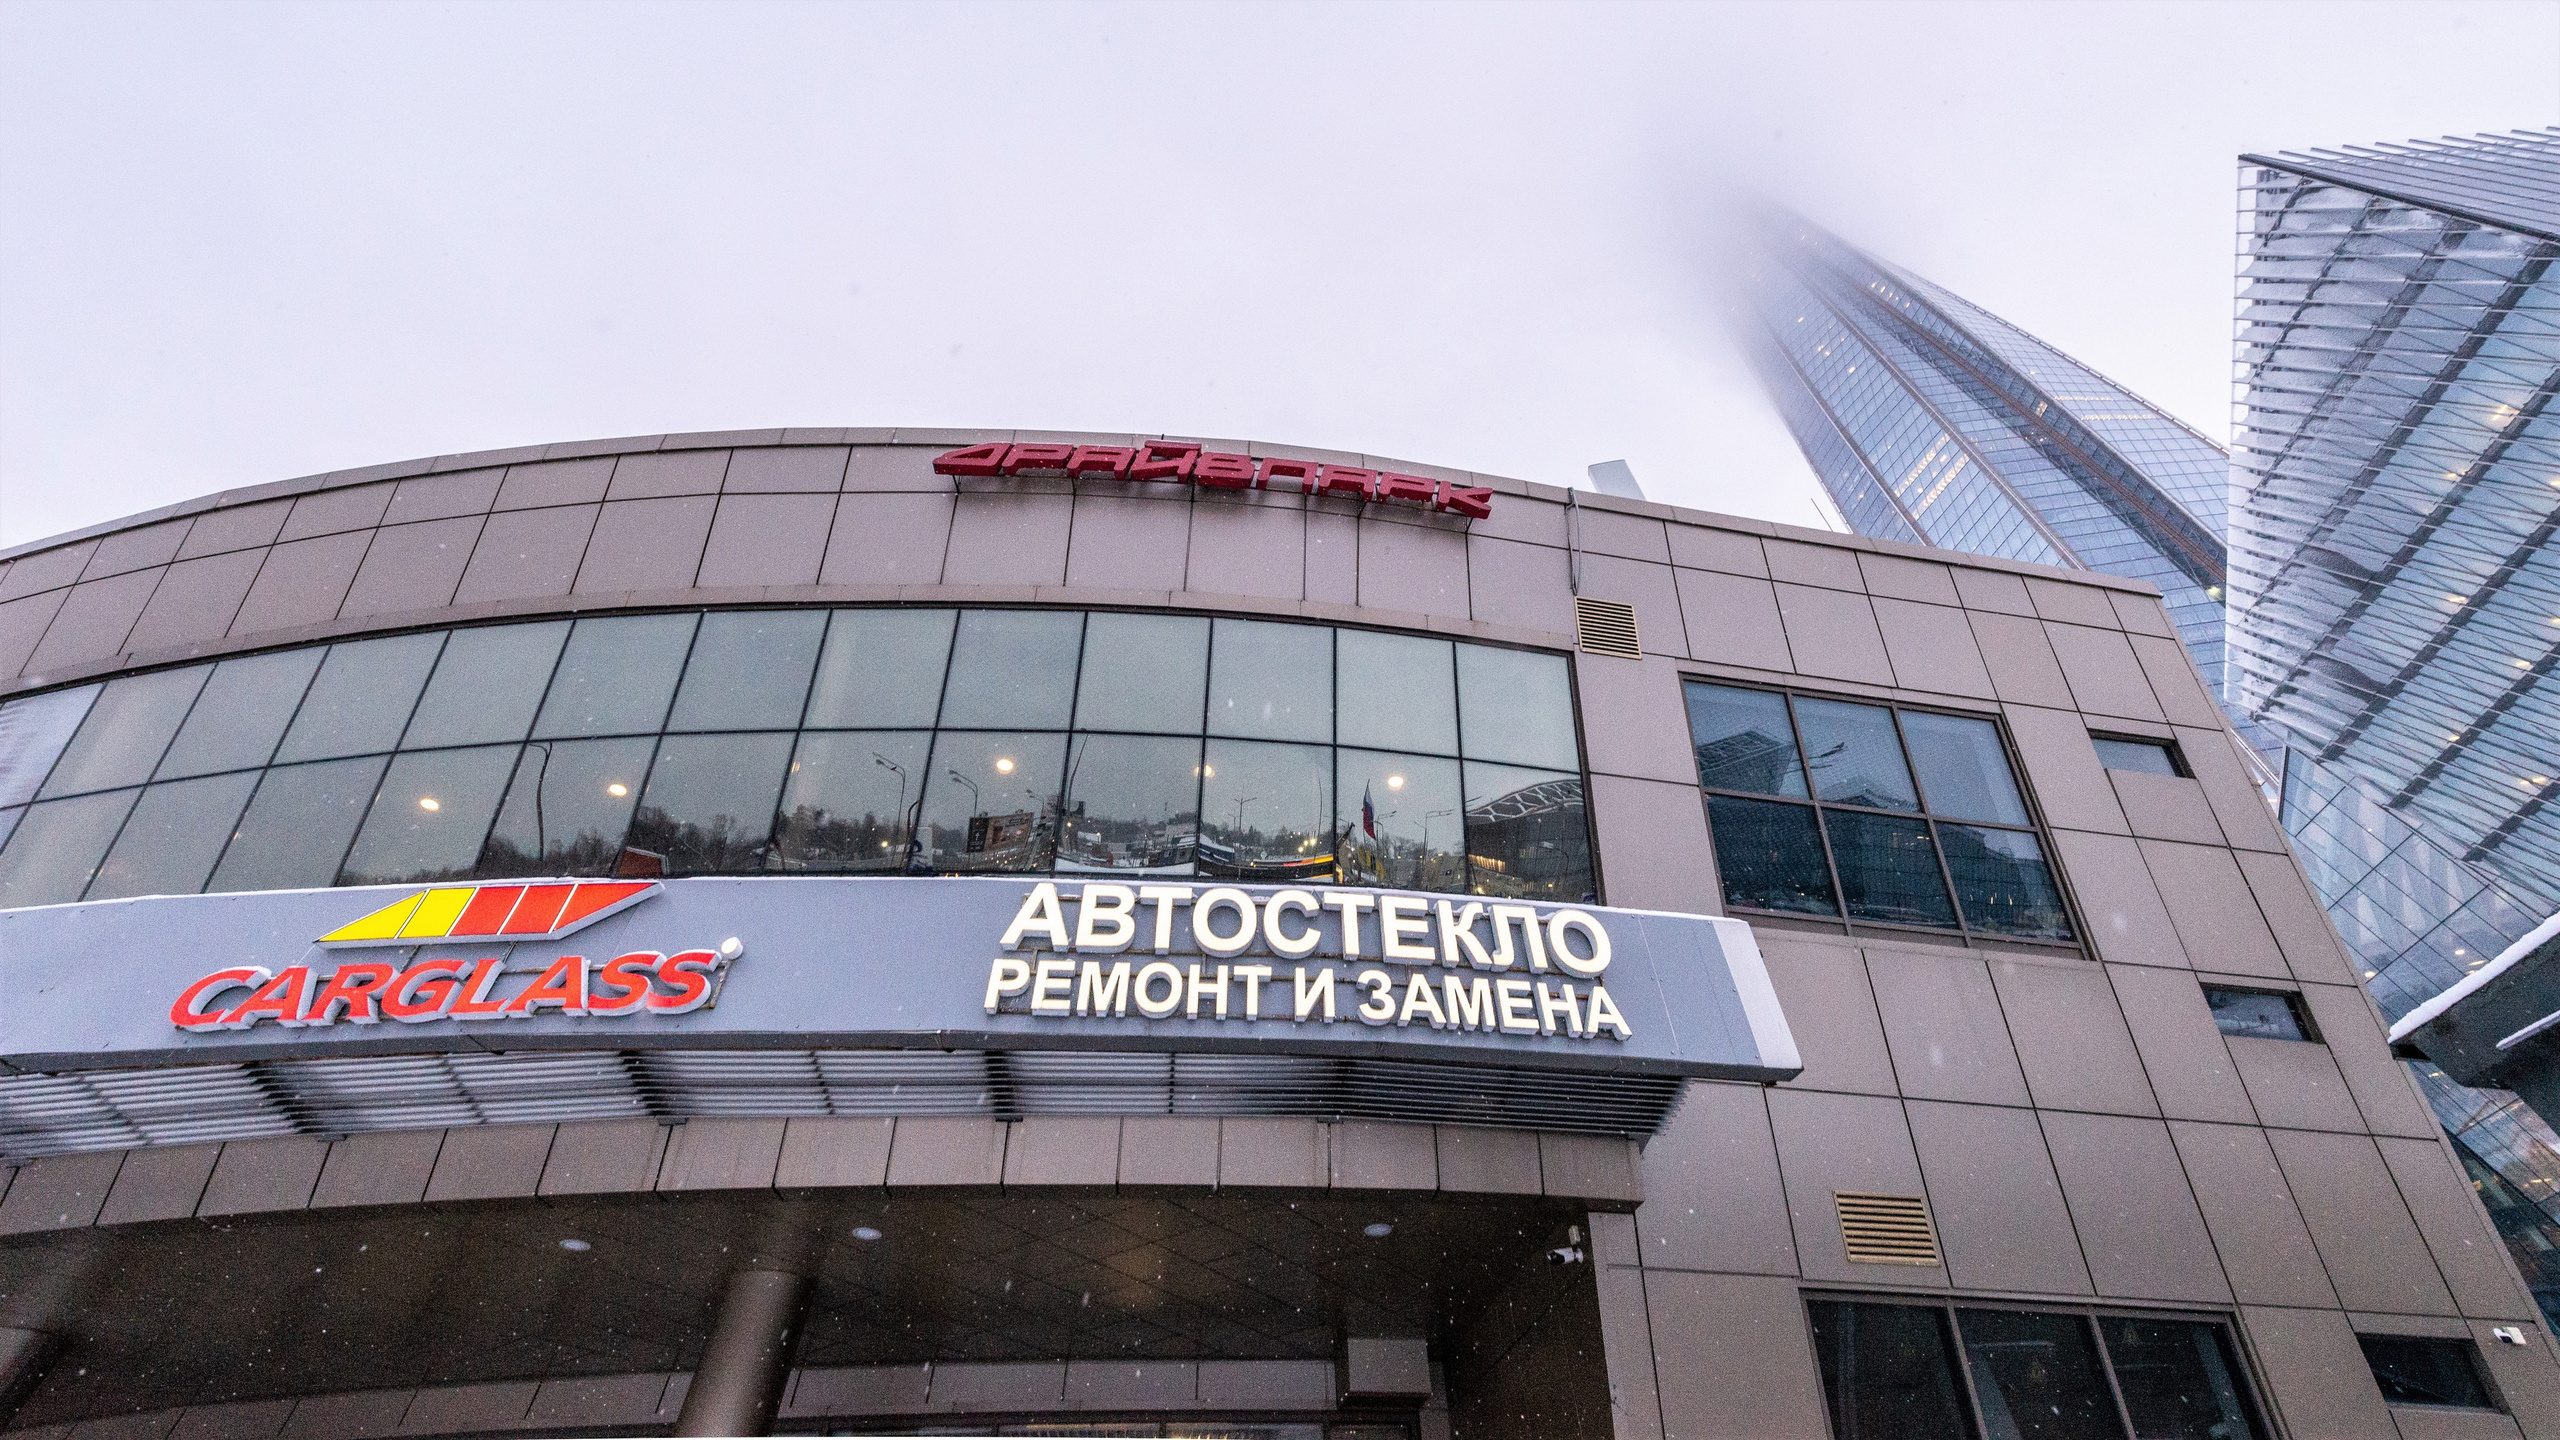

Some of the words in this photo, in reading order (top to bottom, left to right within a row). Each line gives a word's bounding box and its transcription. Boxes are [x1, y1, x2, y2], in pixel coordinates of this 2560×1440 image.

[933, 440, 1493, 519] ДРАЙВПАРК
[999, 882, 1612, 978] АВТОСТЕКЛО
[170, 950, 722, 1031] CARGLASS
[984, 958, 1272, 1020] РЕМОНТ
[1293, 967, 1334, 1023] И
[1356, 969, 1632, 1041] ЗАМЕНА
